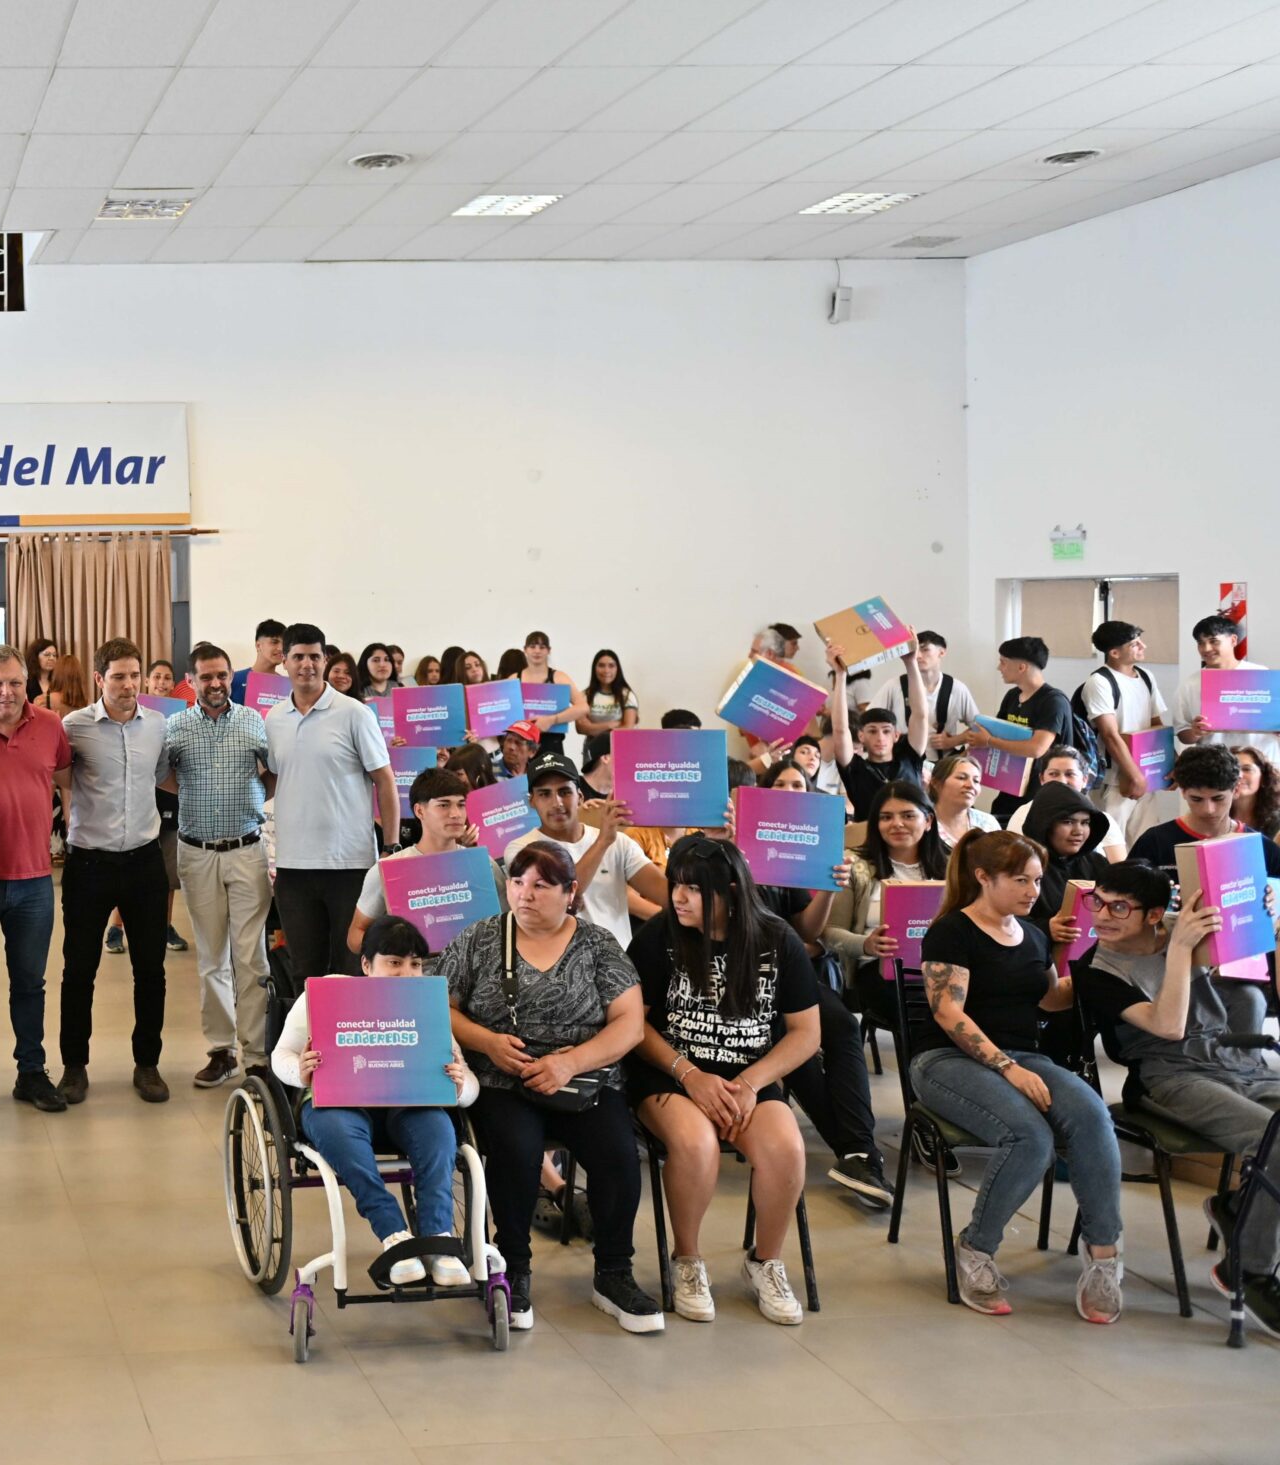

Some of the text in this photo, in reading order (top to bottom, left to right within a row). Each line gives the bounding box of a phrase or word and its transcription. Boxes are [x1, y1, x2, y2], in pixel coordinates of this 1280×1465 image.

[65, 446, 166, 485] Mar
[668, 761, 700, 770] igualdad
[758, 821, 819, 833] conectar igualdad
[408, 881, 468, 896] conectar igualdad
[336, 1019, 416, 1030] conectar igualdad
[680, 1018, 713, 1033] YOUTH
[716, 1025, 738, 1036] FOR
[739, 1026, 761, 1036] THE
[680, 1031, 767, 1048] GLOBAL CHANGE
